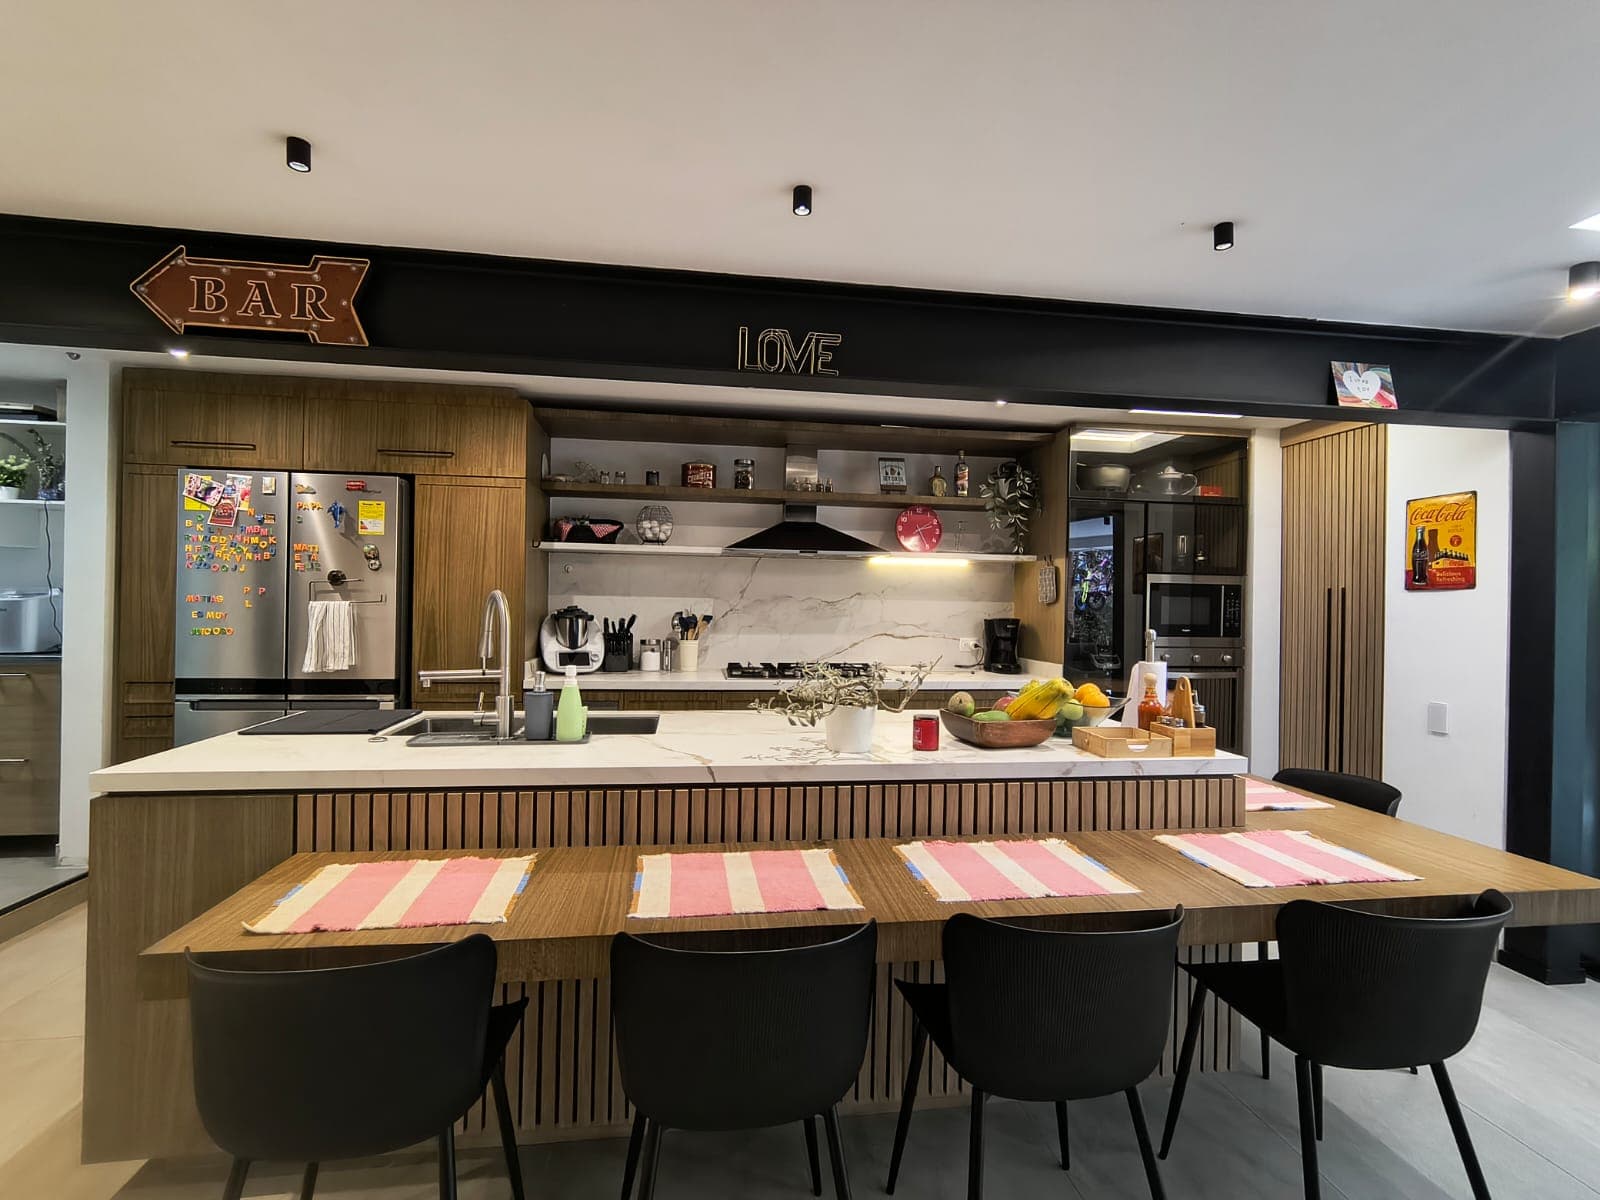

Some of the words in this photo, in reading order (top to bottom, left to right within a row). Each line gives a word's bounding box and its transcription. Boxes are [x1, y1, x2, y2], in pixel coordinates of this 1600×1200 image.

[188, 275, 335, 322] BAR
[737, 326, 842, 376] LOVE
[1410, 502, 1469, 525] Coca-Cola
